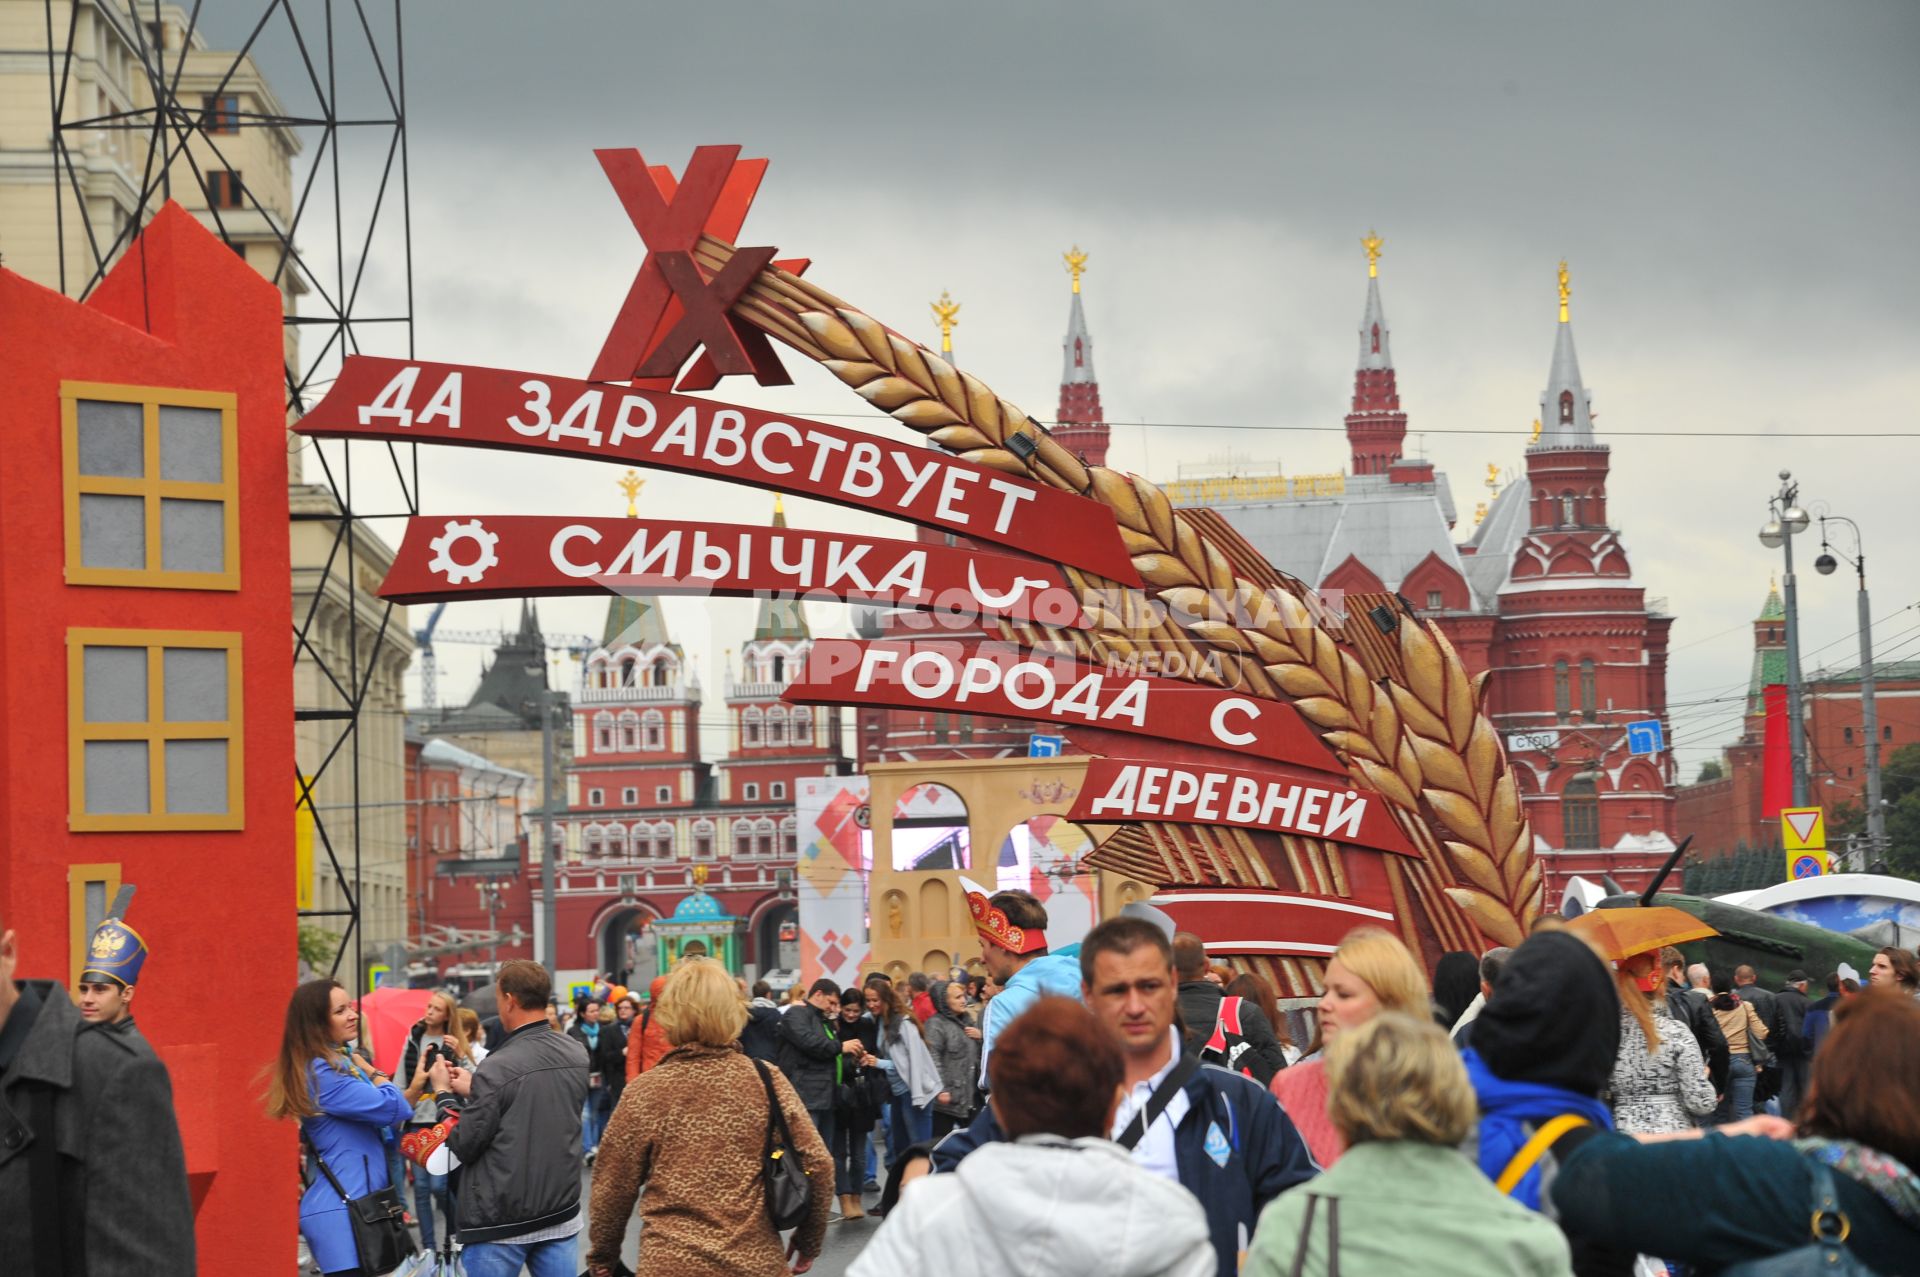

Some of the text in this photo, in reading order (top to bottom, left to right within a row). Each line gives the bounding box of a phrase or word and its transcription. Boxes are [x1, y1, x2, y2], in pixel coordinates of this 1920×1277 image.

[358, 367, 1038, 535] ДА ЗДРАВСТВУЕТ
[549, 525, 928, 598] СМЫЧКА
[854, 649, 1262, 746] ГОРОДА С
[1090, 765, 1368, 838] ДЕРЕВНЕЙ
